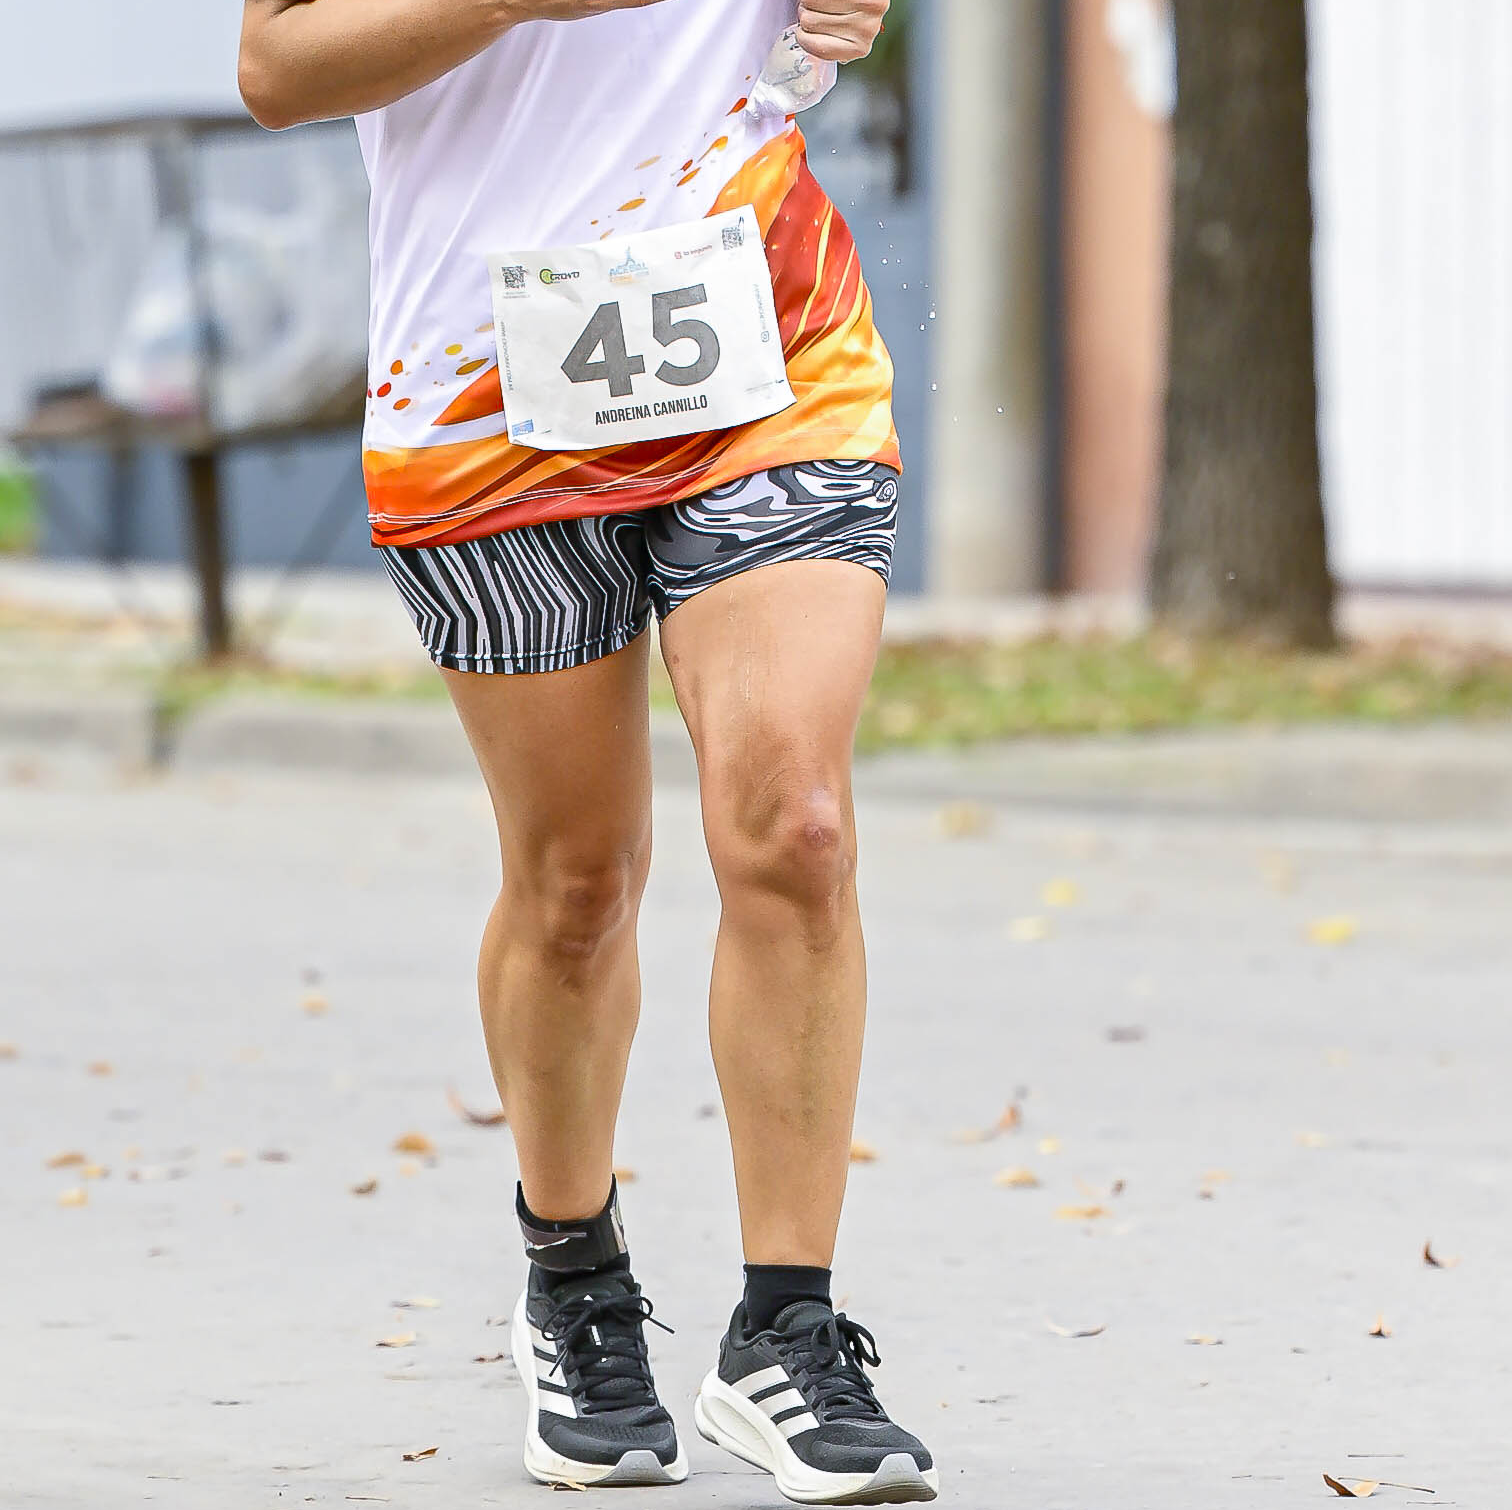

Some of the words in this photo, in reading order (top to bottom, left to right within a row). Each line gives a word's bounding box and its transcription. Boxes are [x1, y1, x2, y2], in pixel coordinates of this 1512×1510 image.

[561, 283, 721, 397] 45
[595, 404, 651, 426] ANDREINA
[653, 394, 708, 417] CANNILLO
